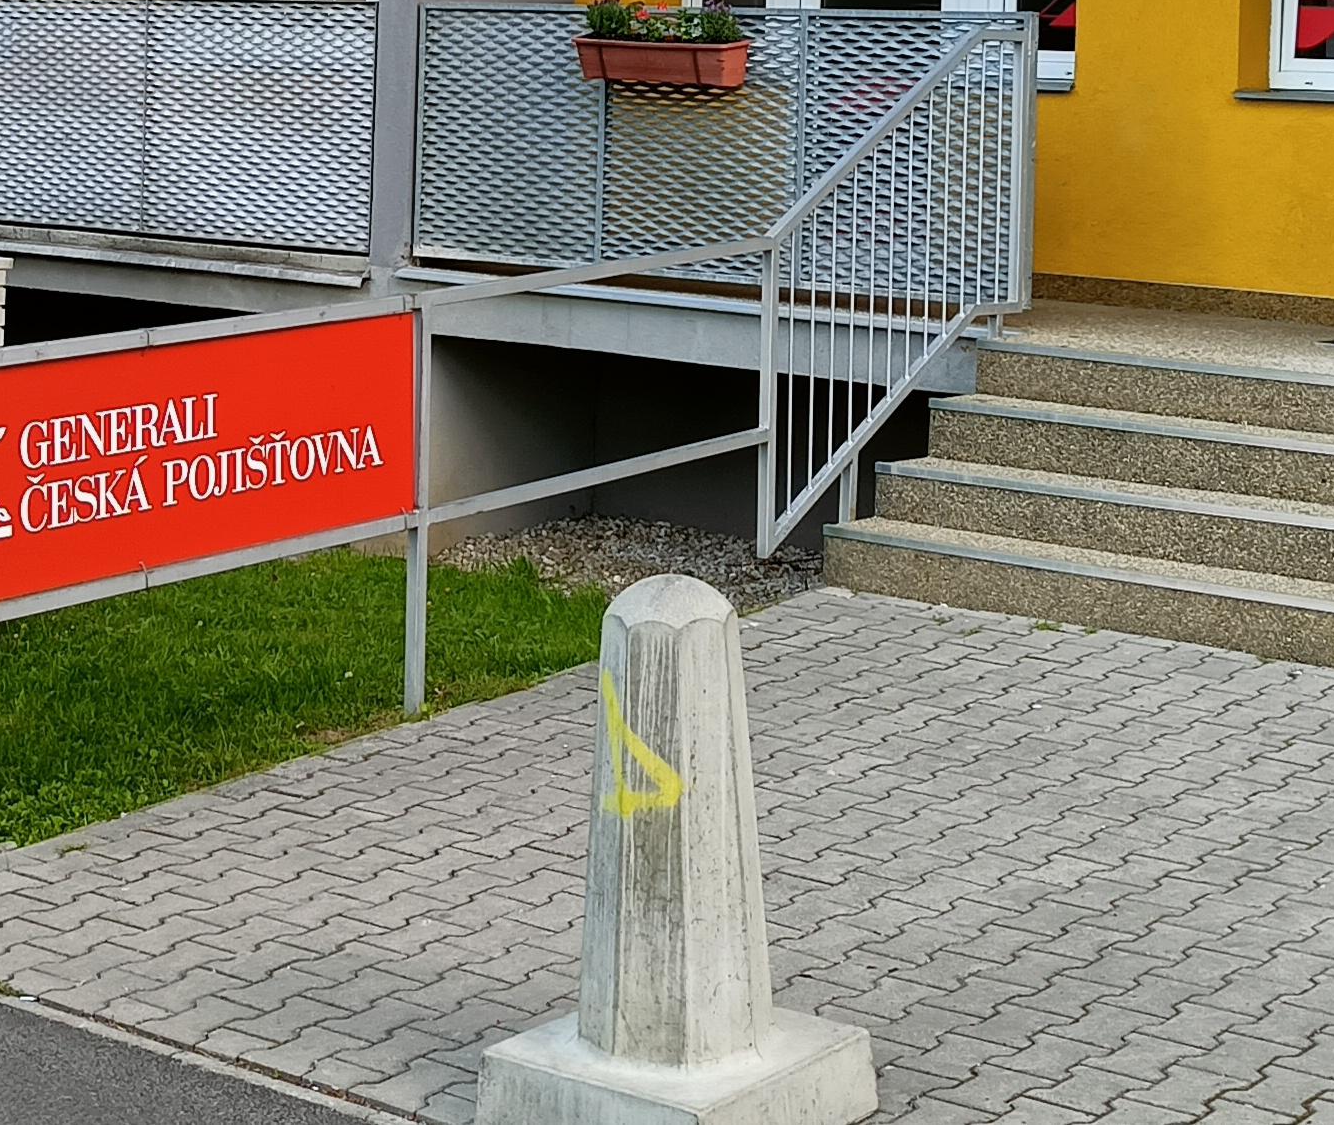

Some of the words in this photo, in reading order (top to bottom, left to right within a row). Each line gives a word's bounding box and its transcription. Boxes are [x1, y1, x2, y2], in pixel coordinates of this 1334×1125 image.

[19, 392, 220, 470] GENERALI
[19, 454, 153, 534] ČESKÁ
[162, 424, 385, 509] POJIŠŤOVNA
